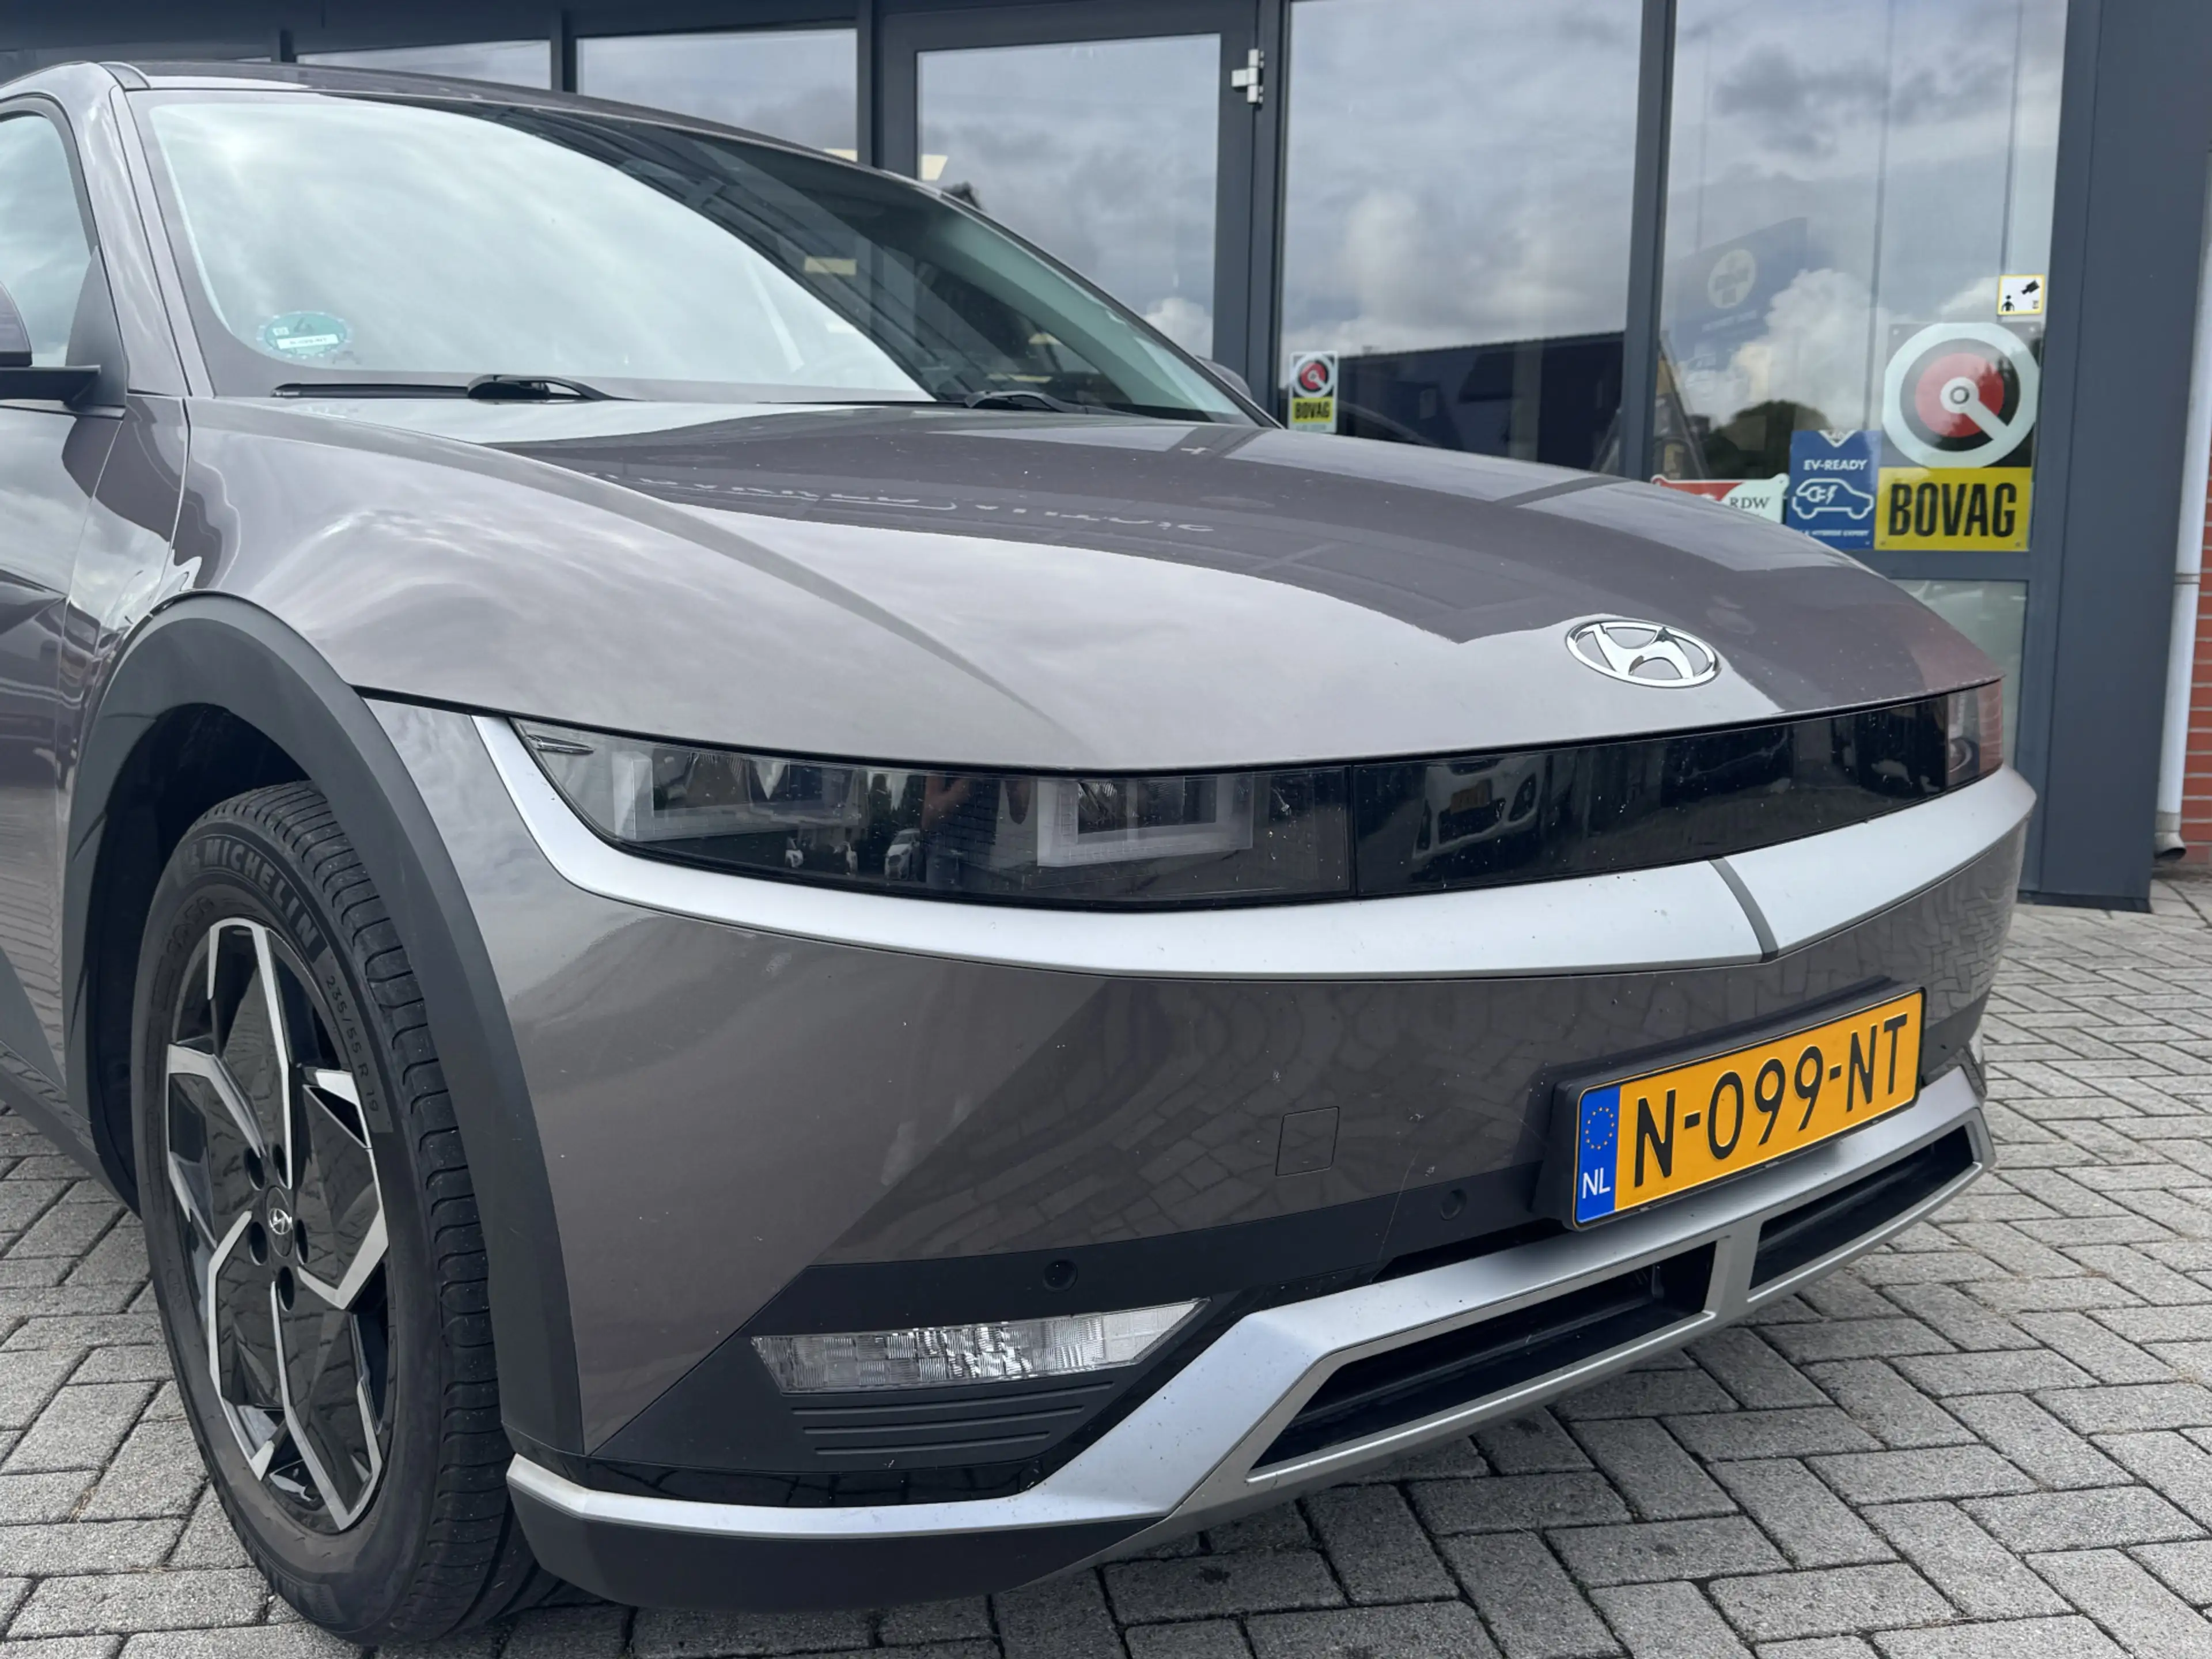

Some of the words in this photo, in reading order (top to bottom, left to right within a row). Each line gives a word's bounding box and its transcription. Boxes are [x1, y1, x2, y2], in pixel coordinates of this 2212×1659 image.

[1296, 402, 1330, 419] BOVAG
[1804, 460, 1868, 471] EV-READY
[1729, 497, 1770, 510] RDW
[1888, 482, 2017, 537] BOVAG
[203, 838, 317, 949] MICHELIN
[326, 975, 362, 1054] 235/55
[1634, 1013, 1908, 1188] N-099-NT
[1582, 1167, 1611, 1199] NL
